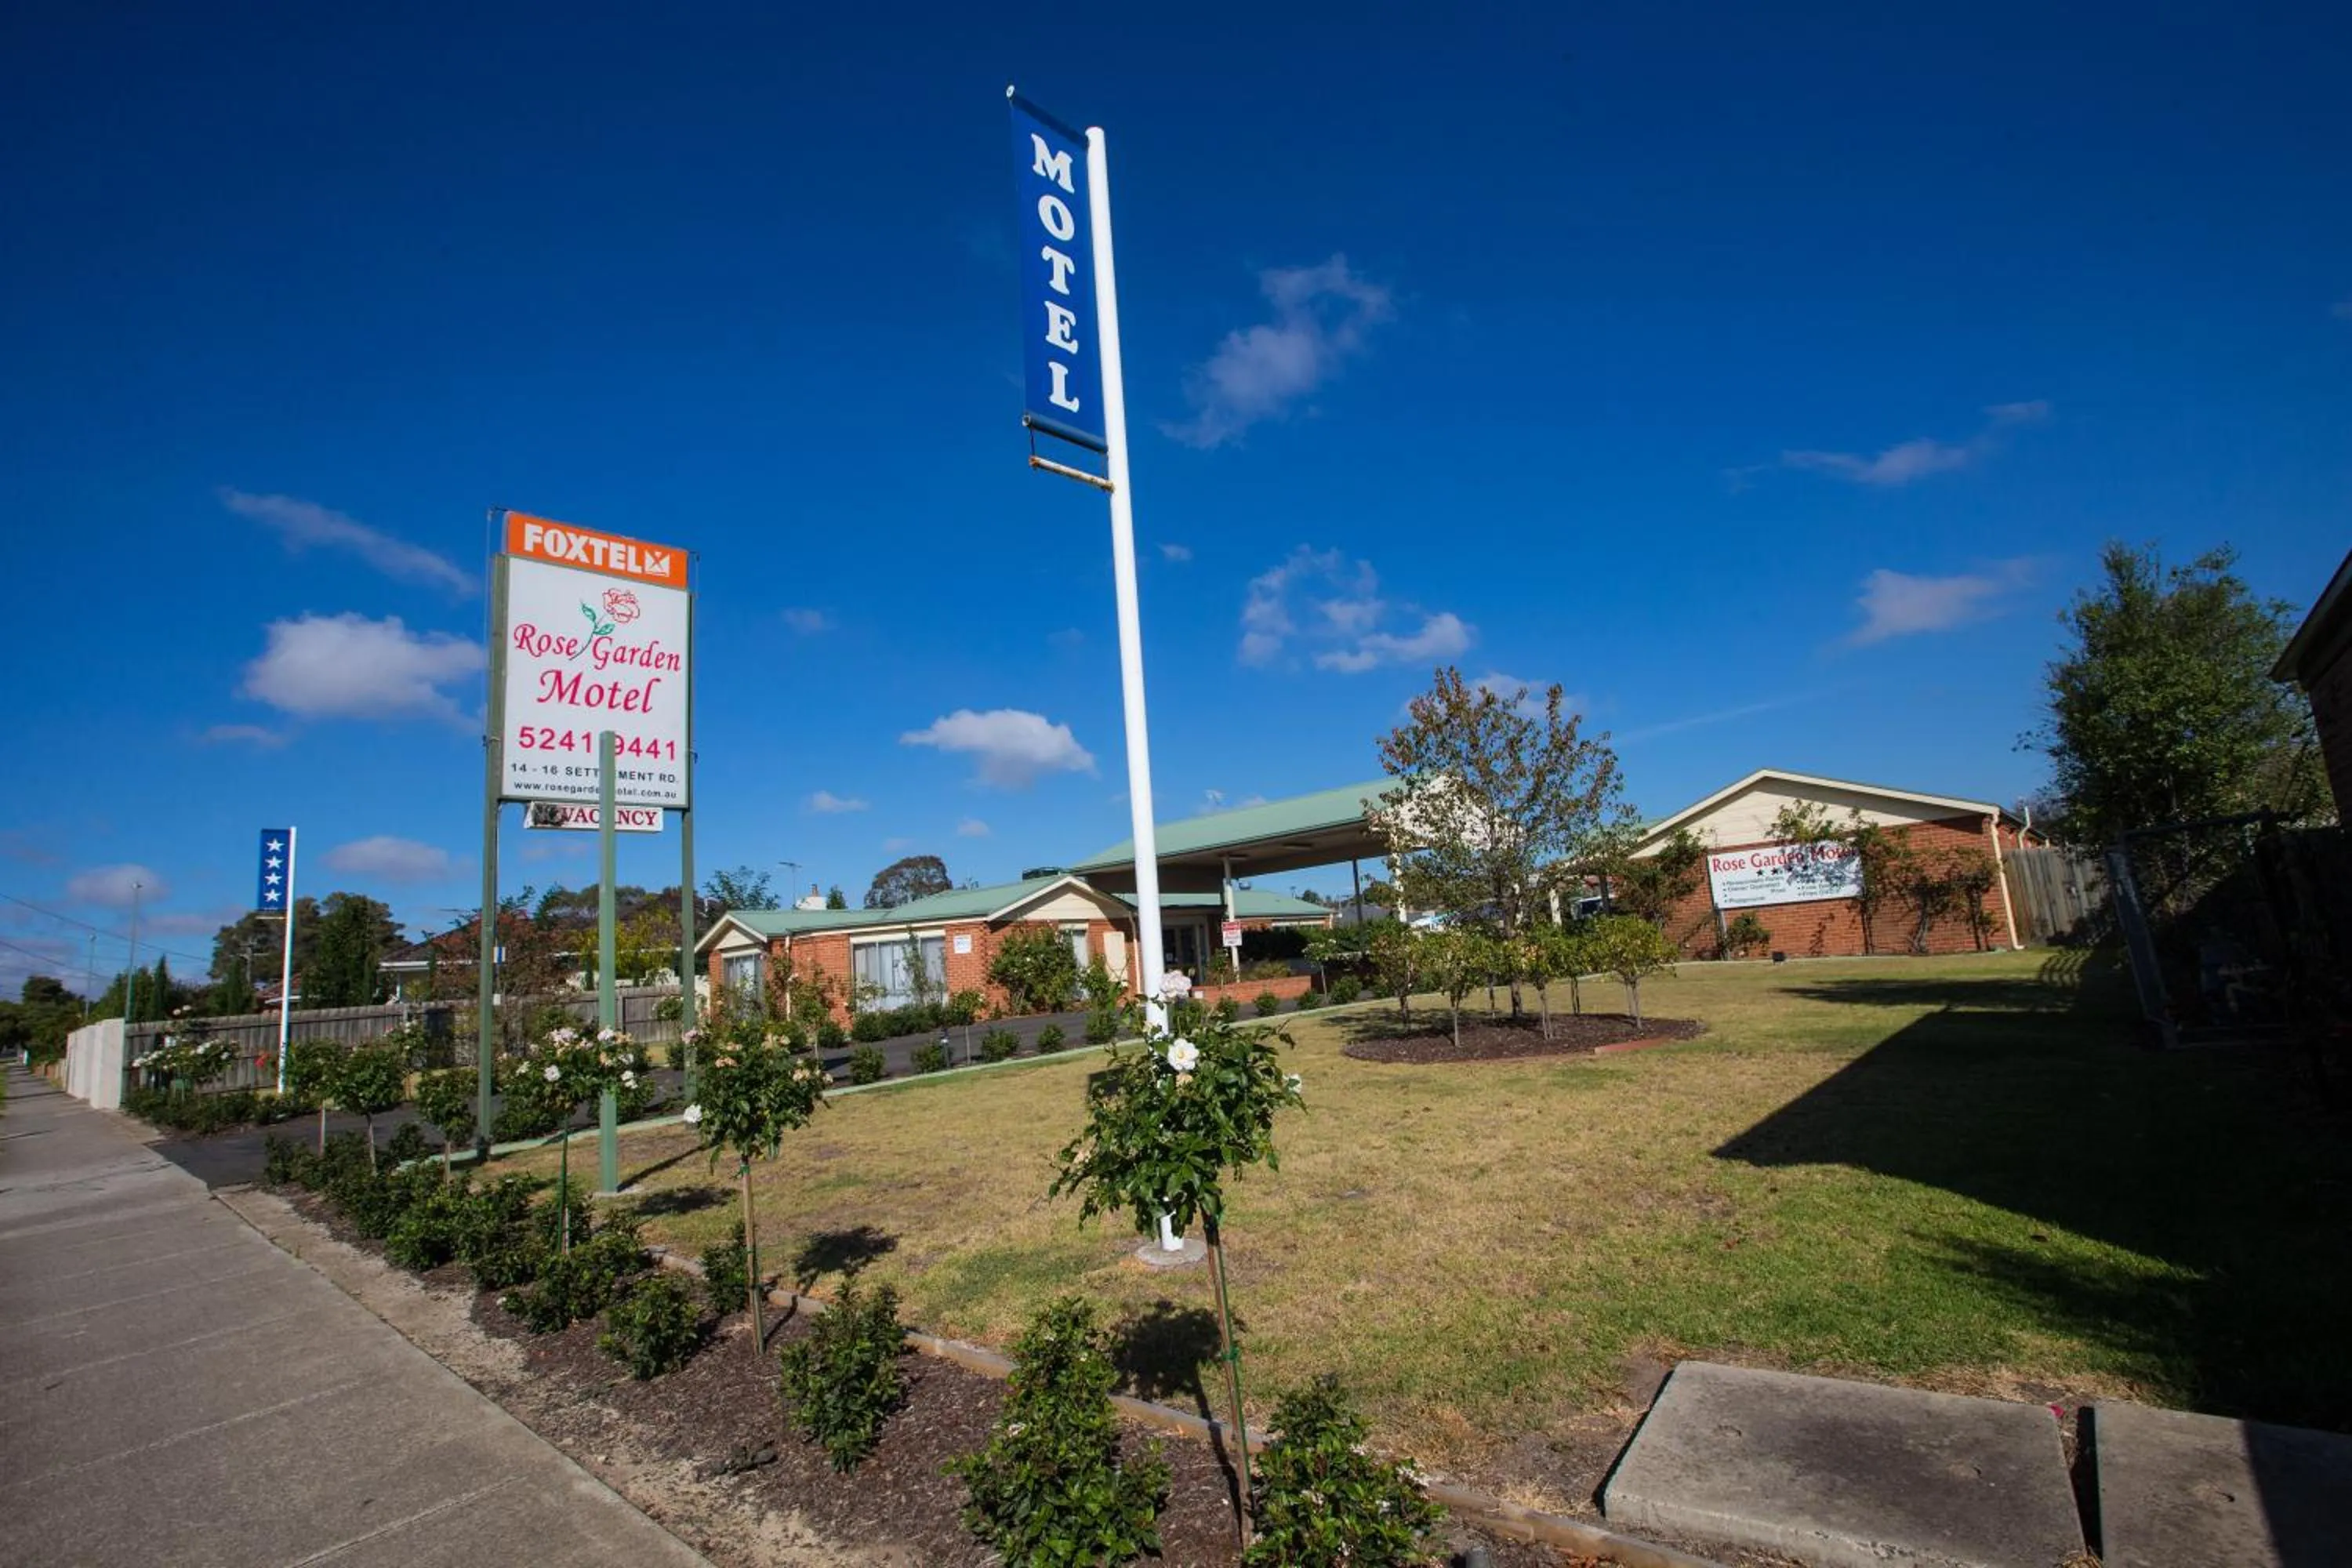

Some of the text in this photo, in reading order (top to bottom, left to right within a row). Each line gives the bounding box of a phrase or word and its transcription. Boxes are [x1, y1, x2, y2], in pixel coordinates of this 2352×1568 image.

[1031, 132, 1080, 413] MOTEL
[524, 521, 642, 574] FOXTEL
[514, 623, 681, 672] Rose Garden
[537, 669, 661, 713] Motel
[518, 726, 677, 761] 5241 9441
[511, 763, 527, 773] 14
[543, 765, 557, 775] 16
[565, 766, 654, 782] SETTMENT
[514, 782, 677, 799] www.rosegardeotel.com.au
[562, 807, 657, 826] VACNCY
[1712, 857, 1746, 873] Rose
[1750, 851, 1805, 868] Garden
